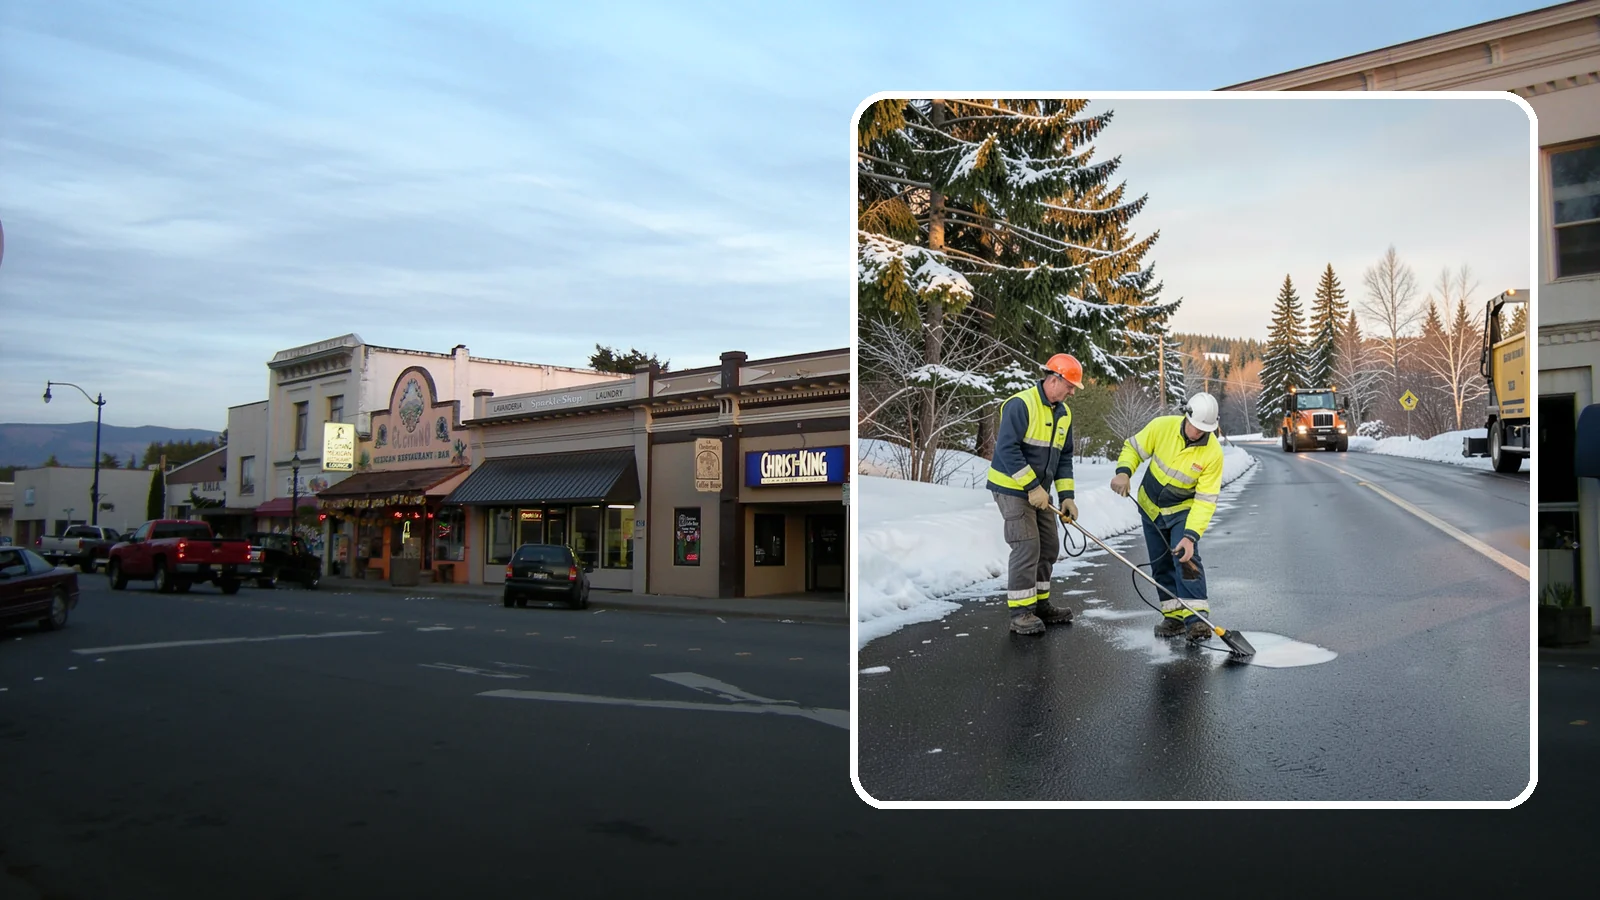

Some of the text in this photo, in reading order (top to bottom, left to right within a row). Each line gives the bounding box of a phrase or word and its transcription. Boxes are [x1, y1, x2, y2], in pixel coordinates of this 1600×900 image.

[595, 389, 623, 400] LAUNDRY
[493, 402, 523, 413] LAVANDERIA
[530, 394, 582, 409] Sparkle Shop
[374, 450, 450, 464] MEXICAN RESTAURANT BAR
